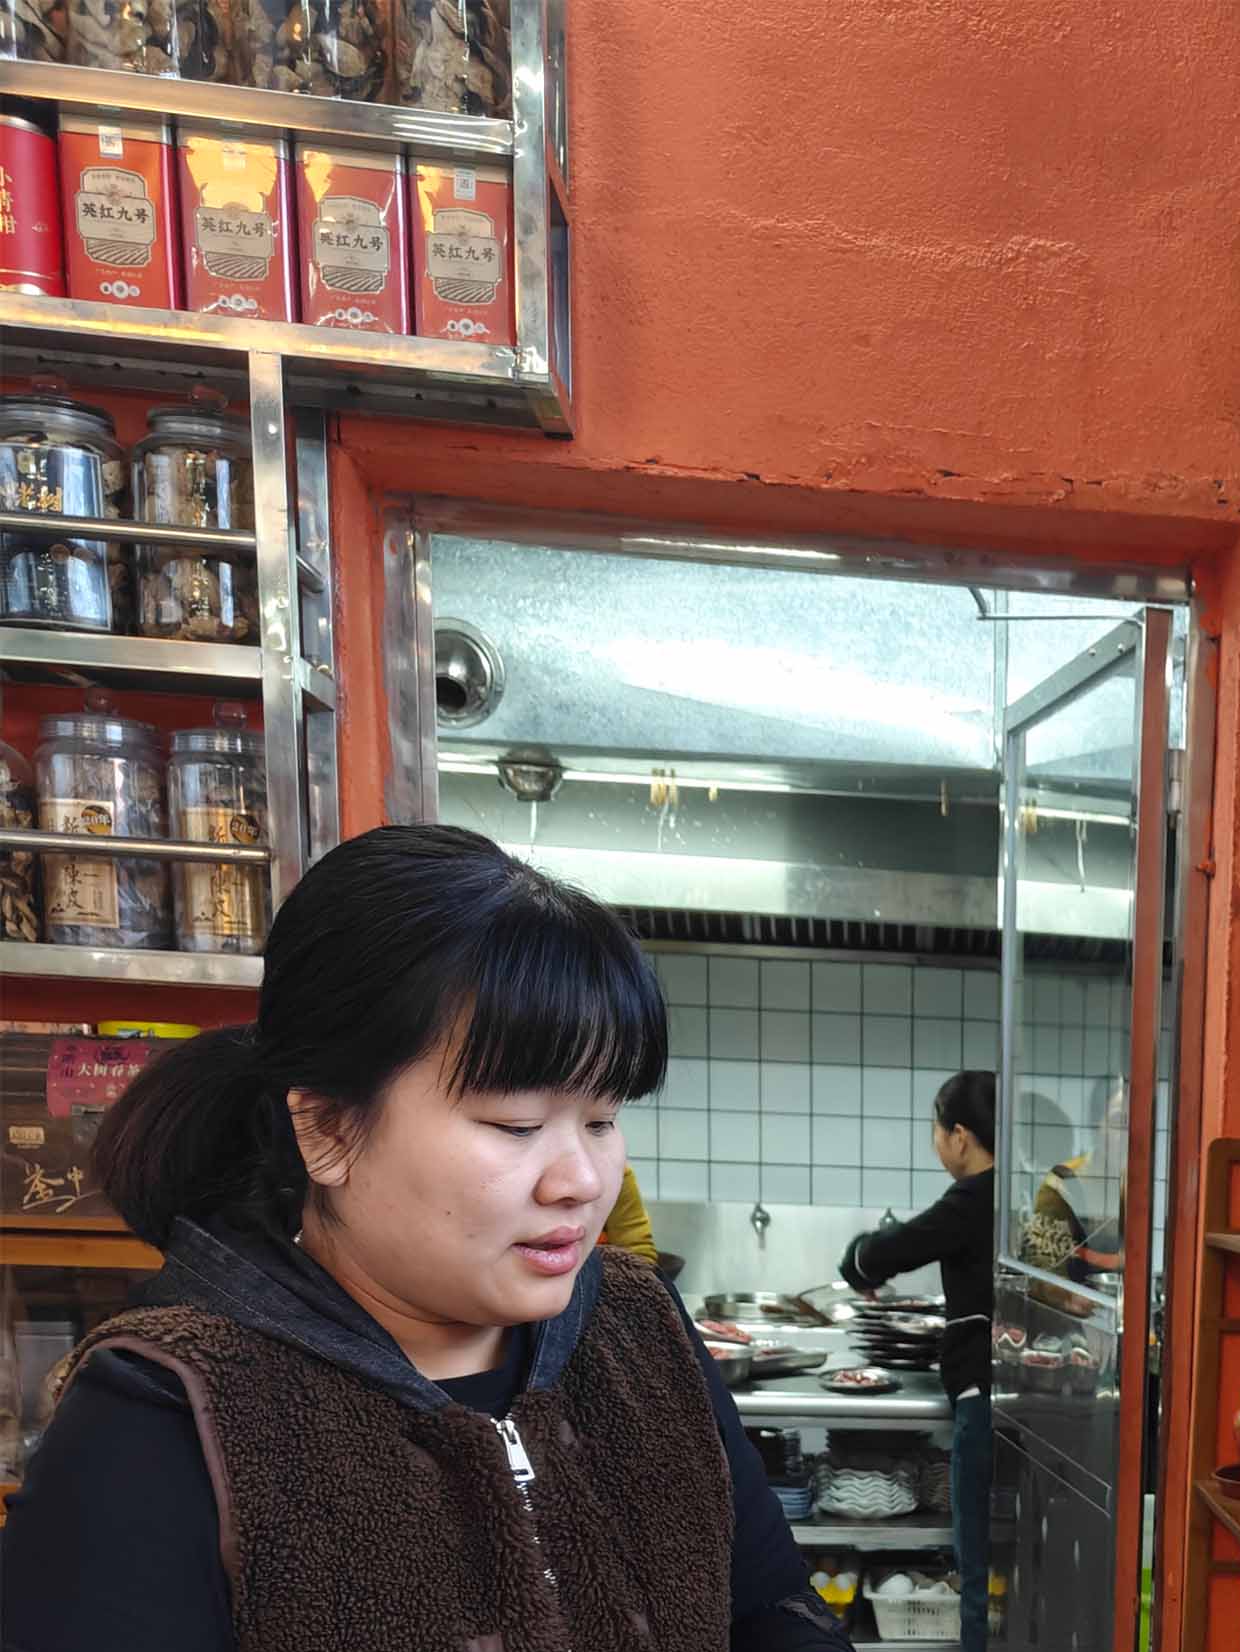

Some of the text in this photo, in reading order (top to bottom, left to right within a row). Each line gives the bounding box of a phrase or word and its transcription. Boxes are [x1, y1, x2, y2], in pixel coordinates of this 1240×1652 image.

[81, 202, 150, 224] 英红九号
[200, 216, 267, 238] 英红九号
[319, 231, 384, 252] 英红九号
[432, 242, 496, 263] 英红九号
